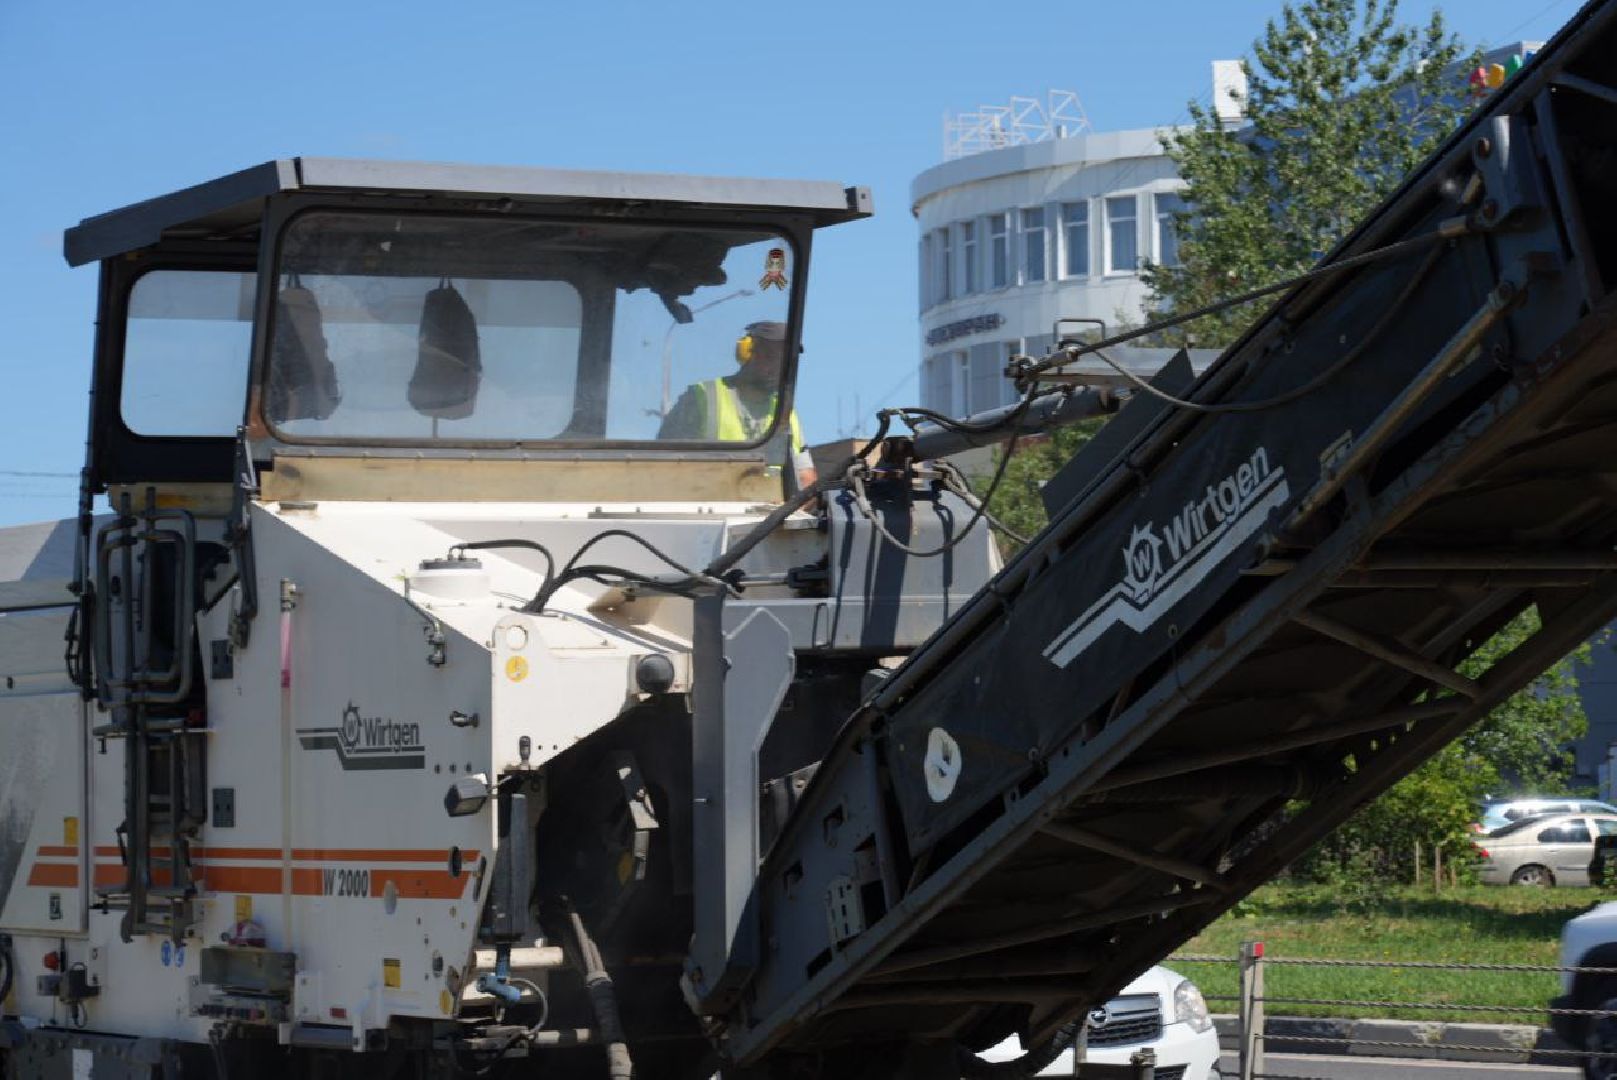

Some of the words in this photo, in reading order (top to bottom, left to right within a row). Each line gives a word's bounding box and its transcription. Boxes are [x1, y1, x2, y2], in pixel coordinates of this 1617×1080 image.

[1163, 446, 1270, 560] Wirtgen
[364, 716, 420, 754] Wirtgen
[323, 869, 336, 896] W
[338, 869, 369, 898] 2000
